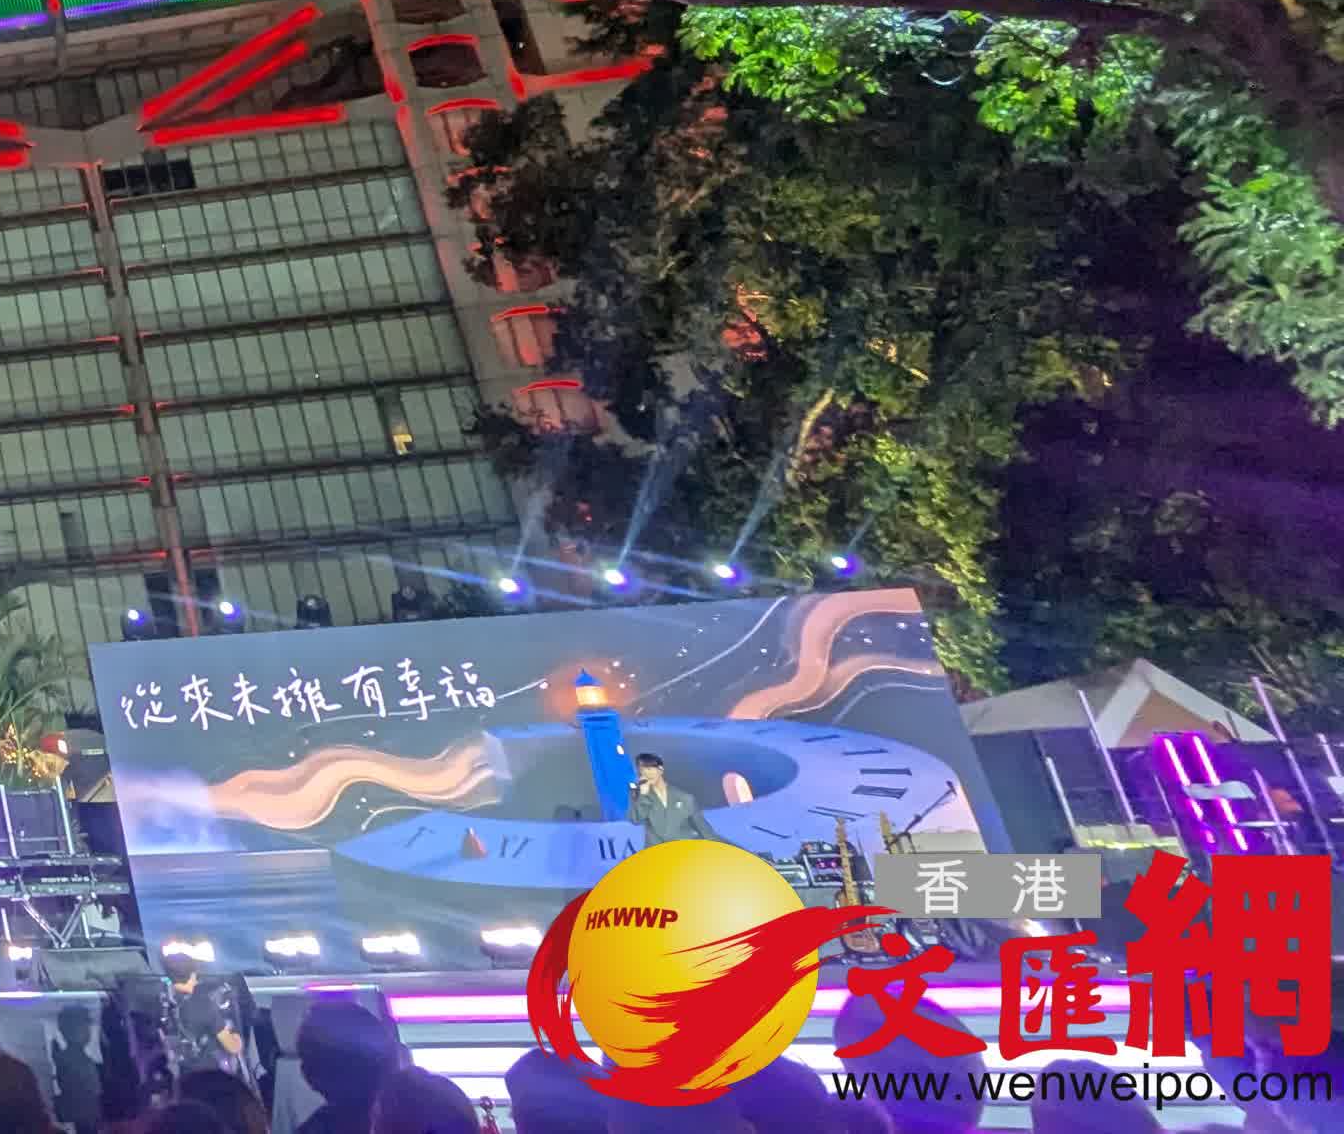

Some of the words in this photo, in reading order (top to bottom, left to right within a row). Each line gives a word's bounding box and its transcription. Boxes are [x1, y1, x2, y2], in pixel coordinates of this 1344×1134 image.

[120, 657, 497, 730] 從來未擁有幸福
